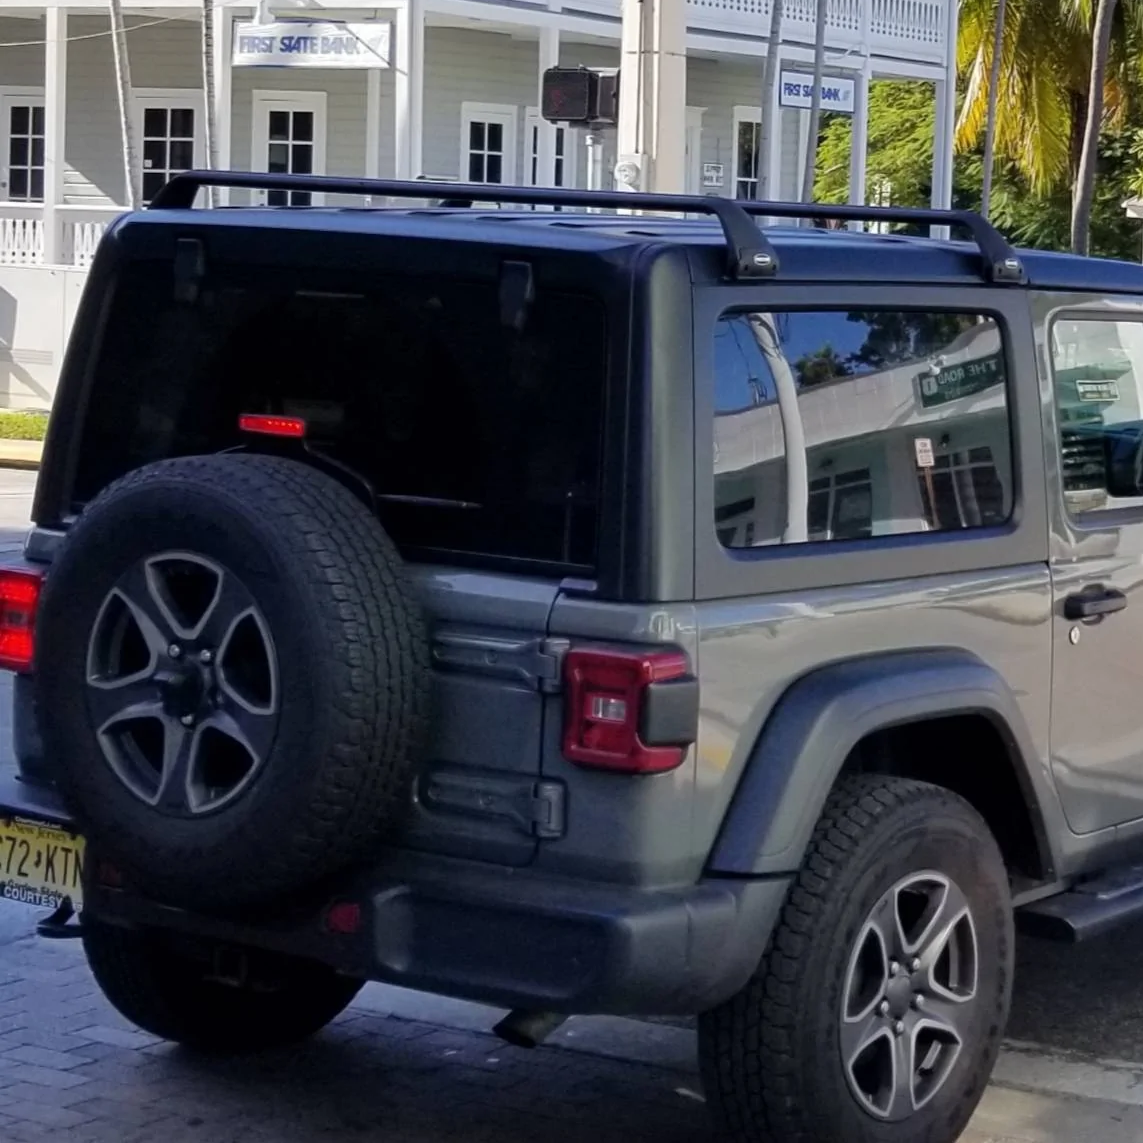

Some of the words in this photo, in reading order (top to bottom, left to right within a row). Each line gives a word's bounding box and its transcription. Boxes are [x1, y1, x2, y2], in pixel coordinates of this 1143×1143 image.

[239, 35, 275, 54] FIRST
[279, 35, 318, 54] STATE
[320, 36, 361, 55] BANK
[0, 835, 31, 877] 72
